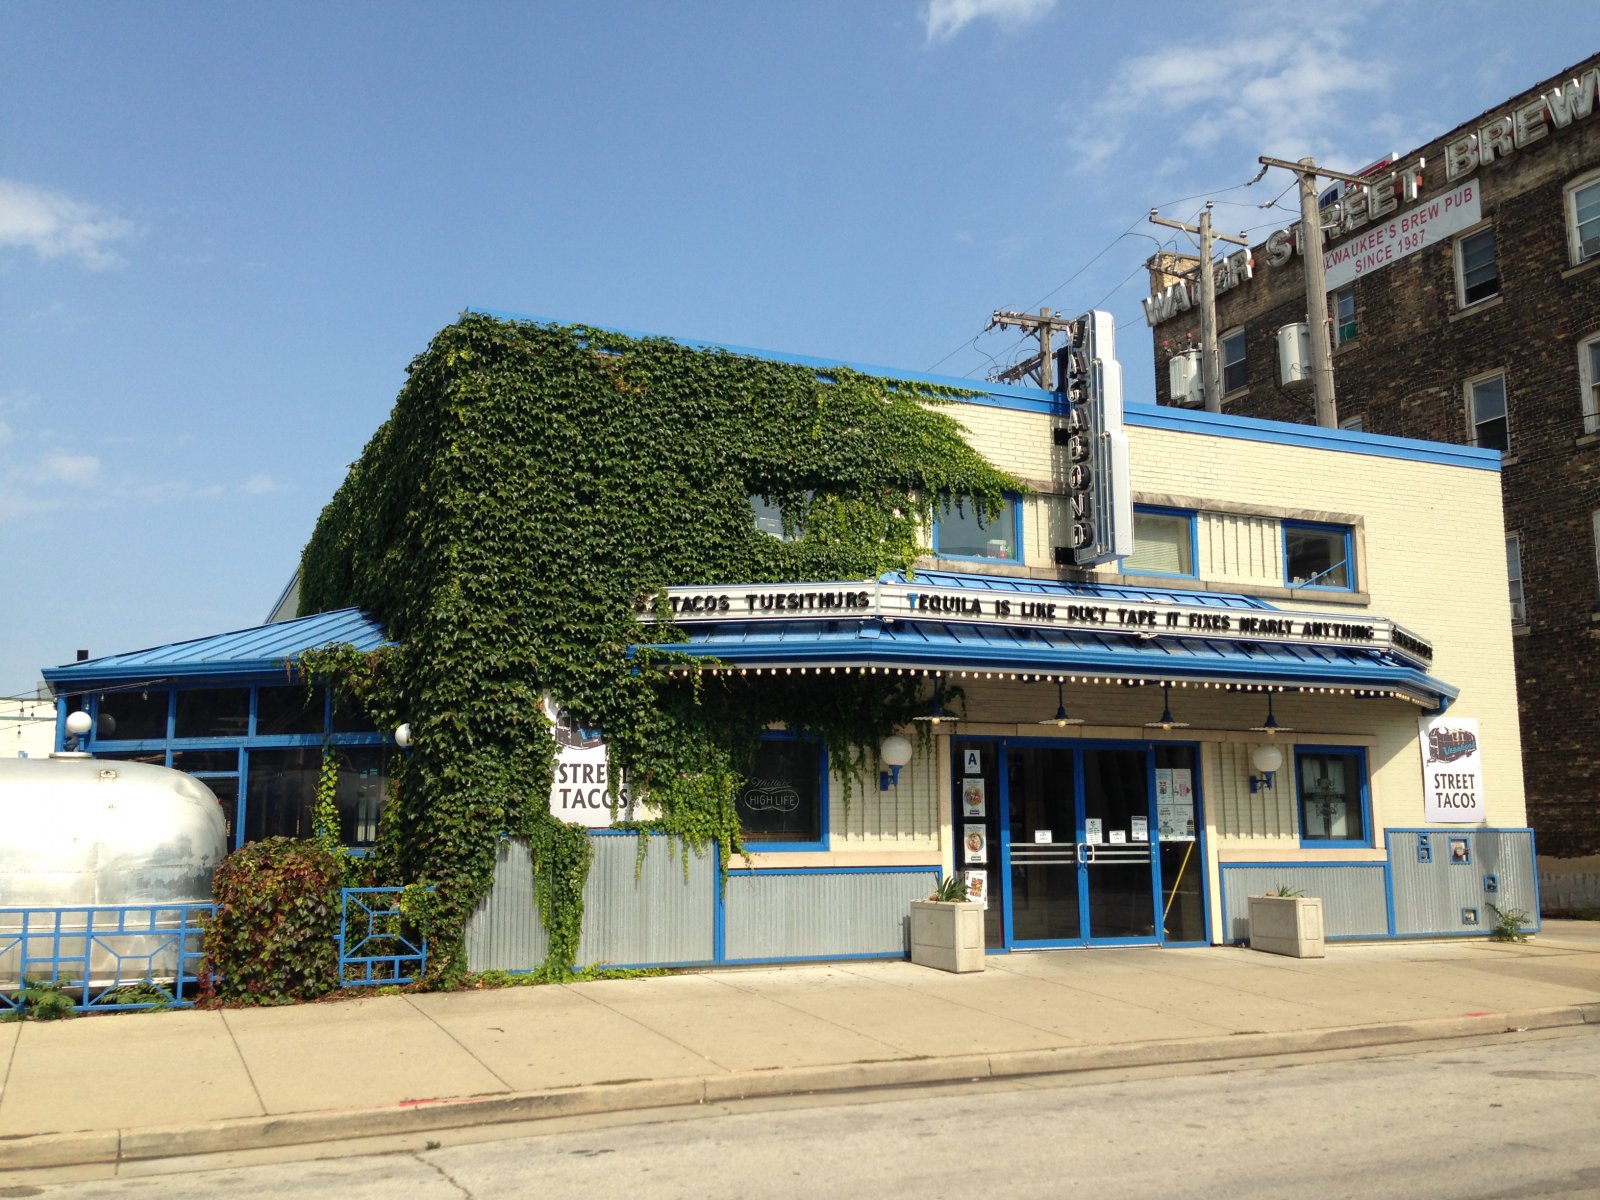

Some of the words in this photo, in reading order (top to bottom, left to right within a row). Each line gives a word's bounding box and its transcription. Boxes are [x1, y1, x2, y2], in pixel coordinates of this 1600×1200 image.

[1445, 67, 1600, 183] BREW
[1323, 224, 1396, 270] LWAUKEE'S
[1401, 202, 1439, 232] BREW
[1445, 187, 1472, 213] PUB
[1355, 245, 1392, 274] SINCE
[1398, 229, 1425, 254] 1987
[669, 595, 730, 613] TACOS
[907, 593, 982, 613] TEQUILA
[996, 599, 1010, 616] IS
[1021, 602, 1056, 619] LIKE
[1069, 605, 1108, 622] DUCT
[1119, 608, 1157, 625] TAPE
[1167, 611, 1181, 627] IT
[1189, 613, 1231, 630] FIXES
[1240, 617, 1294, 634] NEARLY
[1303, 622, 1374, 639] ANYTHING
[968, 753, 977, 765] A
[559, 763, 630, 783] STRET
[1434, 773, 1474, 789] STREET
[750, 795, 773, 805] HIGH
[775, 796, 795, 805] LIFE
[1436, 792, 1476, 808] TACOS
